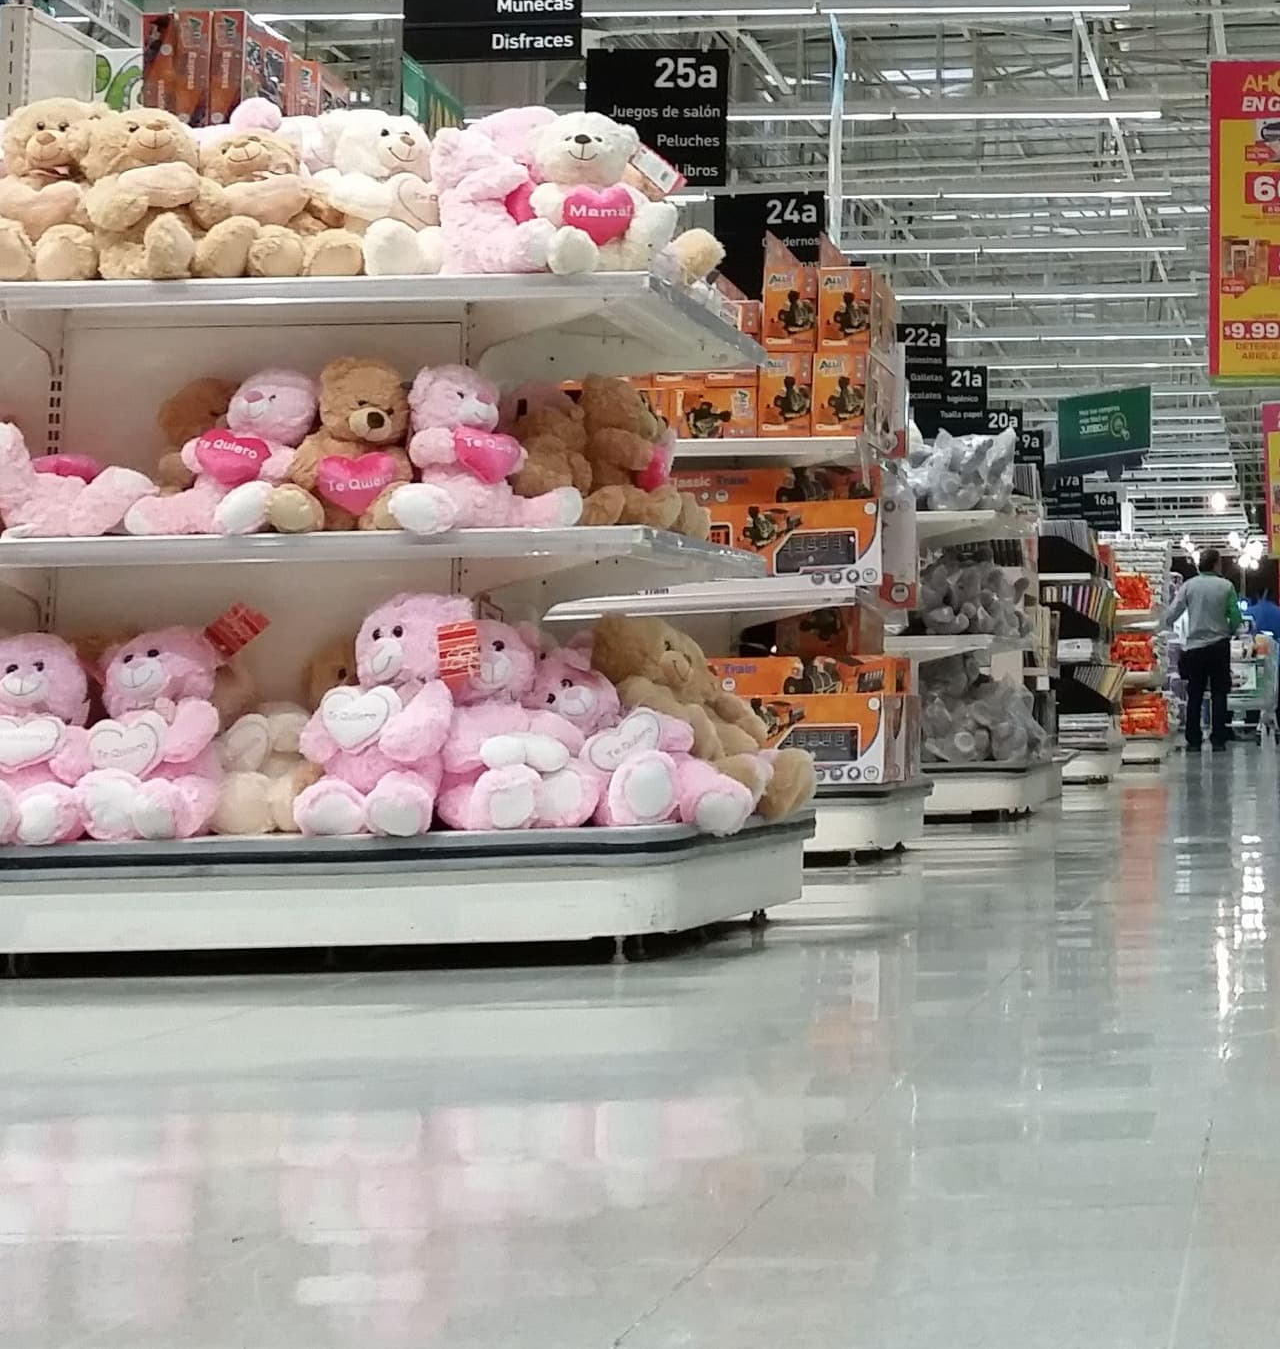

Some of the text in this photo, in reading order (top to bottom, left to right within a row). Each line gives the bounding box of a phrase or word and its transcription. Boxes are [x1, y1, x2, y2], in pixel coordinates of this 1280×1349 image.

[491, 33, 575, 51] Disfraces
[653, 57, 719, 89] 25a
[609, 104, 721, 120] Juegos de salón
[1242, 96, 1266, 112] EN
[656, 134, 720, 148] Peluches
[766, 198, 818, 225] 24a
[904, 327, 941, 348] 22a
[951, 369, 982, 388] 21a
[988, 412, 1019, 429] 20a
[216, 438, 258, 461] Quiero
[1021, 433, 1040, 449] 9a
[1094, 494, 1114, 506] 16a
